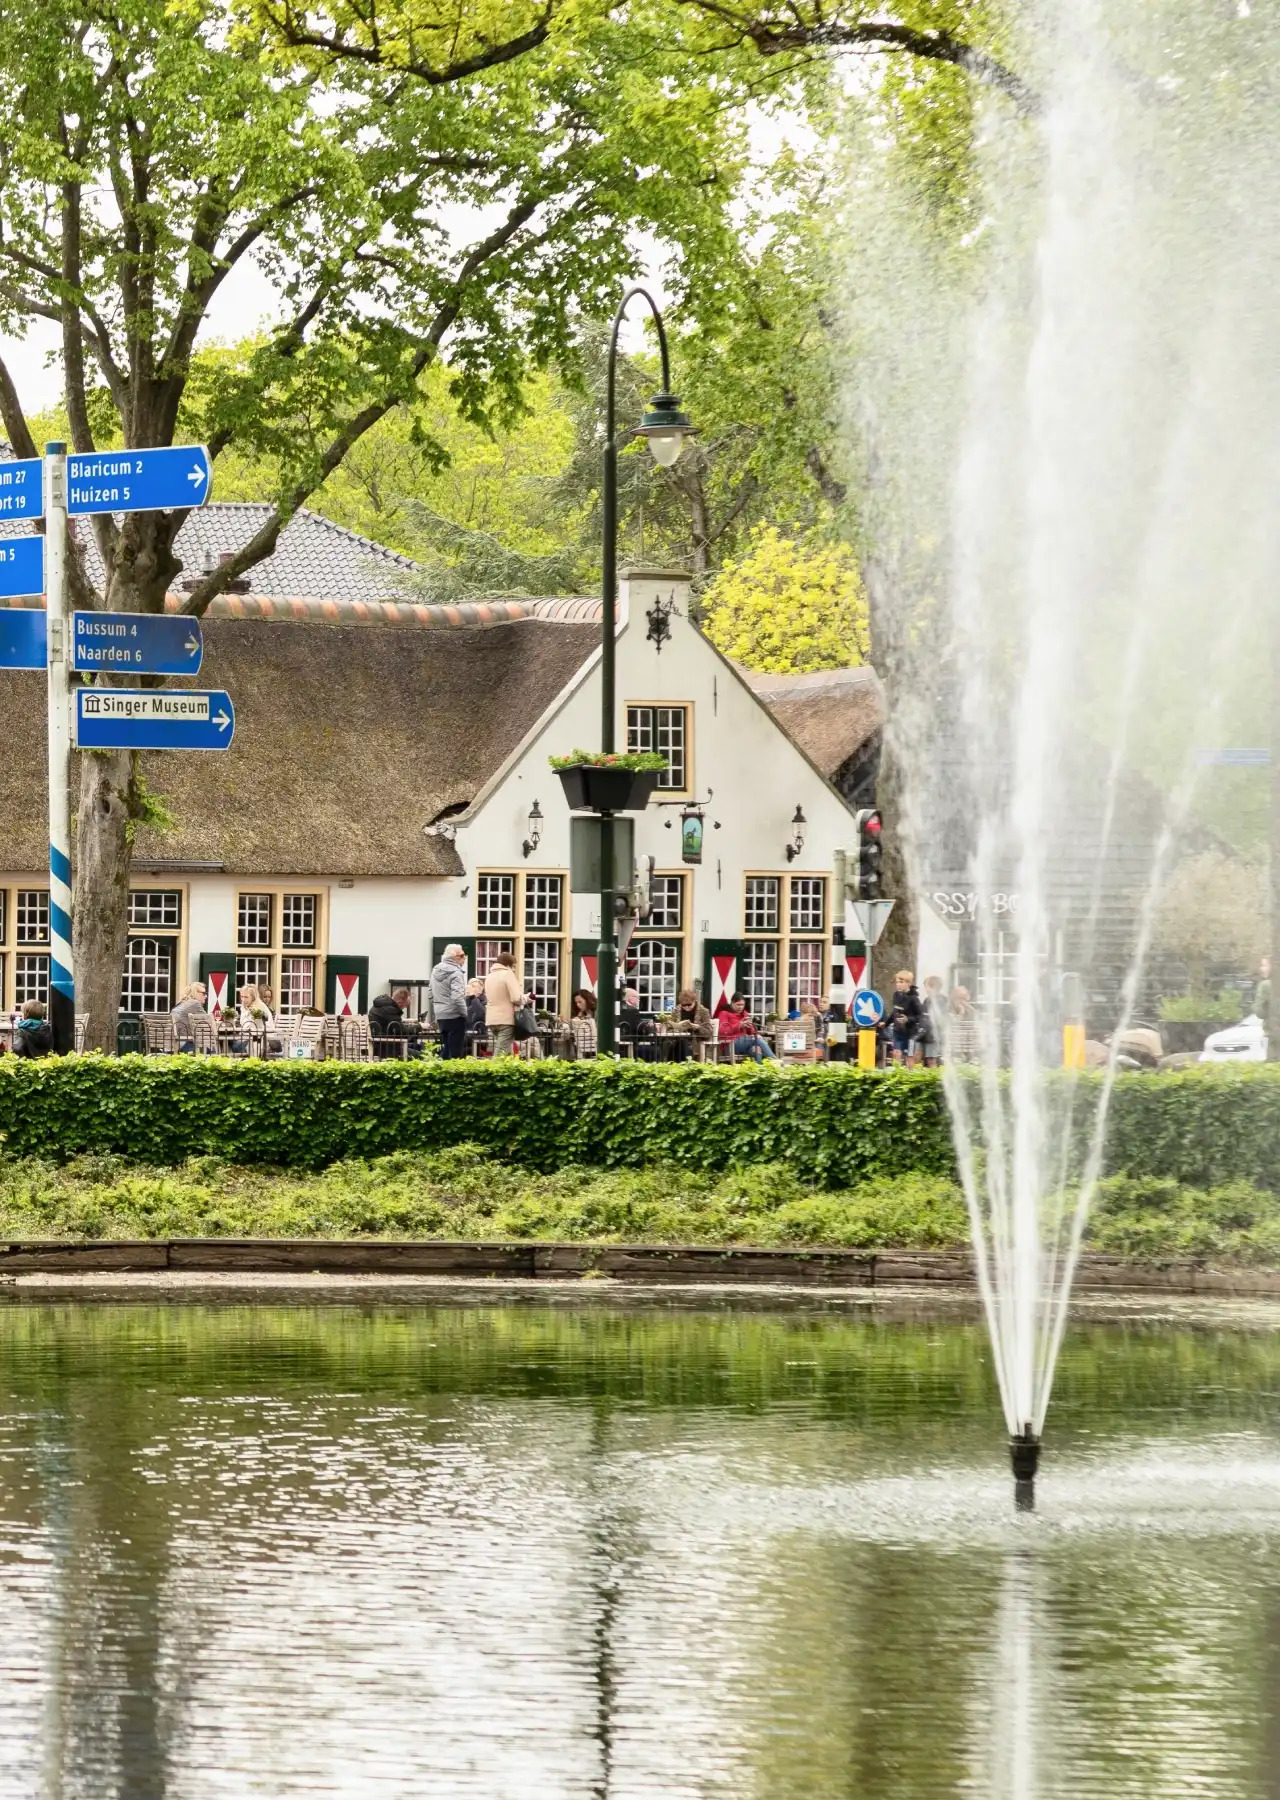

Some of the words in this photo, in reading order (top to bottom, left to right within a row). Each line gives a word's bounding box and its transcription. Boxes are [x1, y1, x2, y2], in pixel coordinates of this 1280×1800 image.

[15, 470, 26, 484] 27
[70, 460, 132, 478] Blaricum
[135, 460, 143, 474] 2
[15, 495, 26, 509] 19
[71, 486, 119, 503] Huizen
[123, 487, 130, 500] 5
[9, 548, 15, 561] 5
[77, 619, 126, 637] Bussum
[130, 624, 138, 637] 4
[77, 644, 131, 661] Naarden
[135, 649, 142, 662] 6
[103, 697, 148, 715] Singer
[152, 698, 208, 715] Museum
